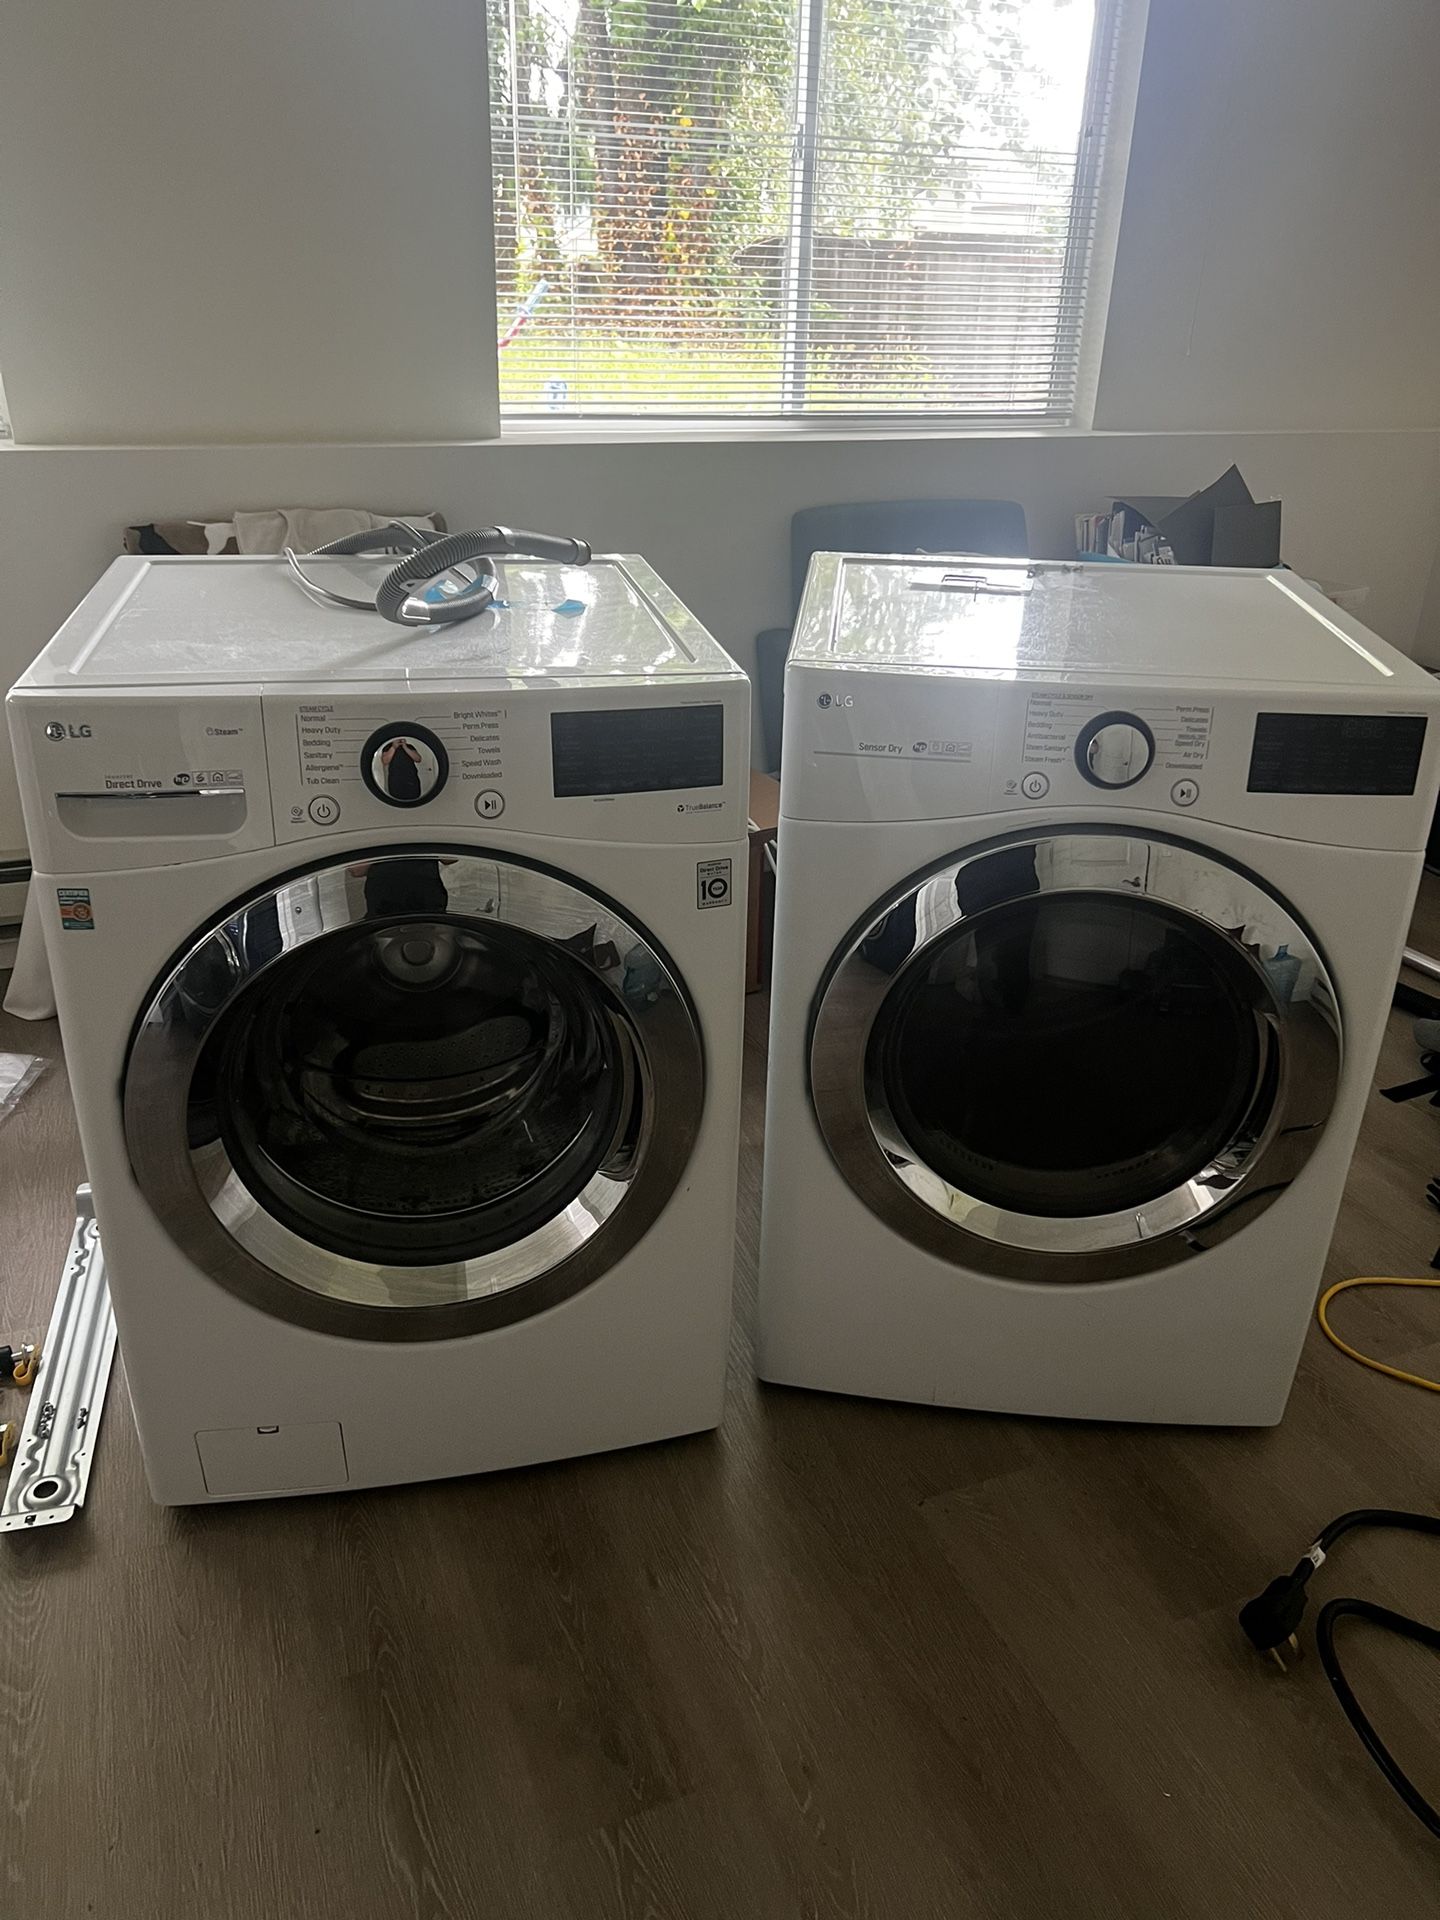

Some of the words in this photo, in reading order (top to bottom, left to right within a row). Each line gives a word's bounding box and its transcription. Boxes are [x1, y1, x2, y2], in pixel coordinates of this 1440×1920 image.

[835, 695, 854, 708] LG
[300, 714, 326, 722] Normal
[453, 711, 474, 720] Bright
[68, 724, 92, 739] LG
[301, 727, 323, 735] Heavy
[325, 727, 341, 735] Duty
[302, 739, 331, 747] Bedding
[1194, 741, 1205, 749] Dry
[478, 746, 501, 754] Towels
[858, 742, 887, 753] Sensor
[888, 743, 903, 754] Dry
[303, 752, 333, 760] Sanitary
[1193, 752, 1204, 760] Dry
[461, 760, 482, 768] Speed
[462, 772, 503, 780] Downloaded
[105, 779, 135, 789] Direct
[137, 778, 162, 788] Drive
[701, 878, 728, 900] 10
